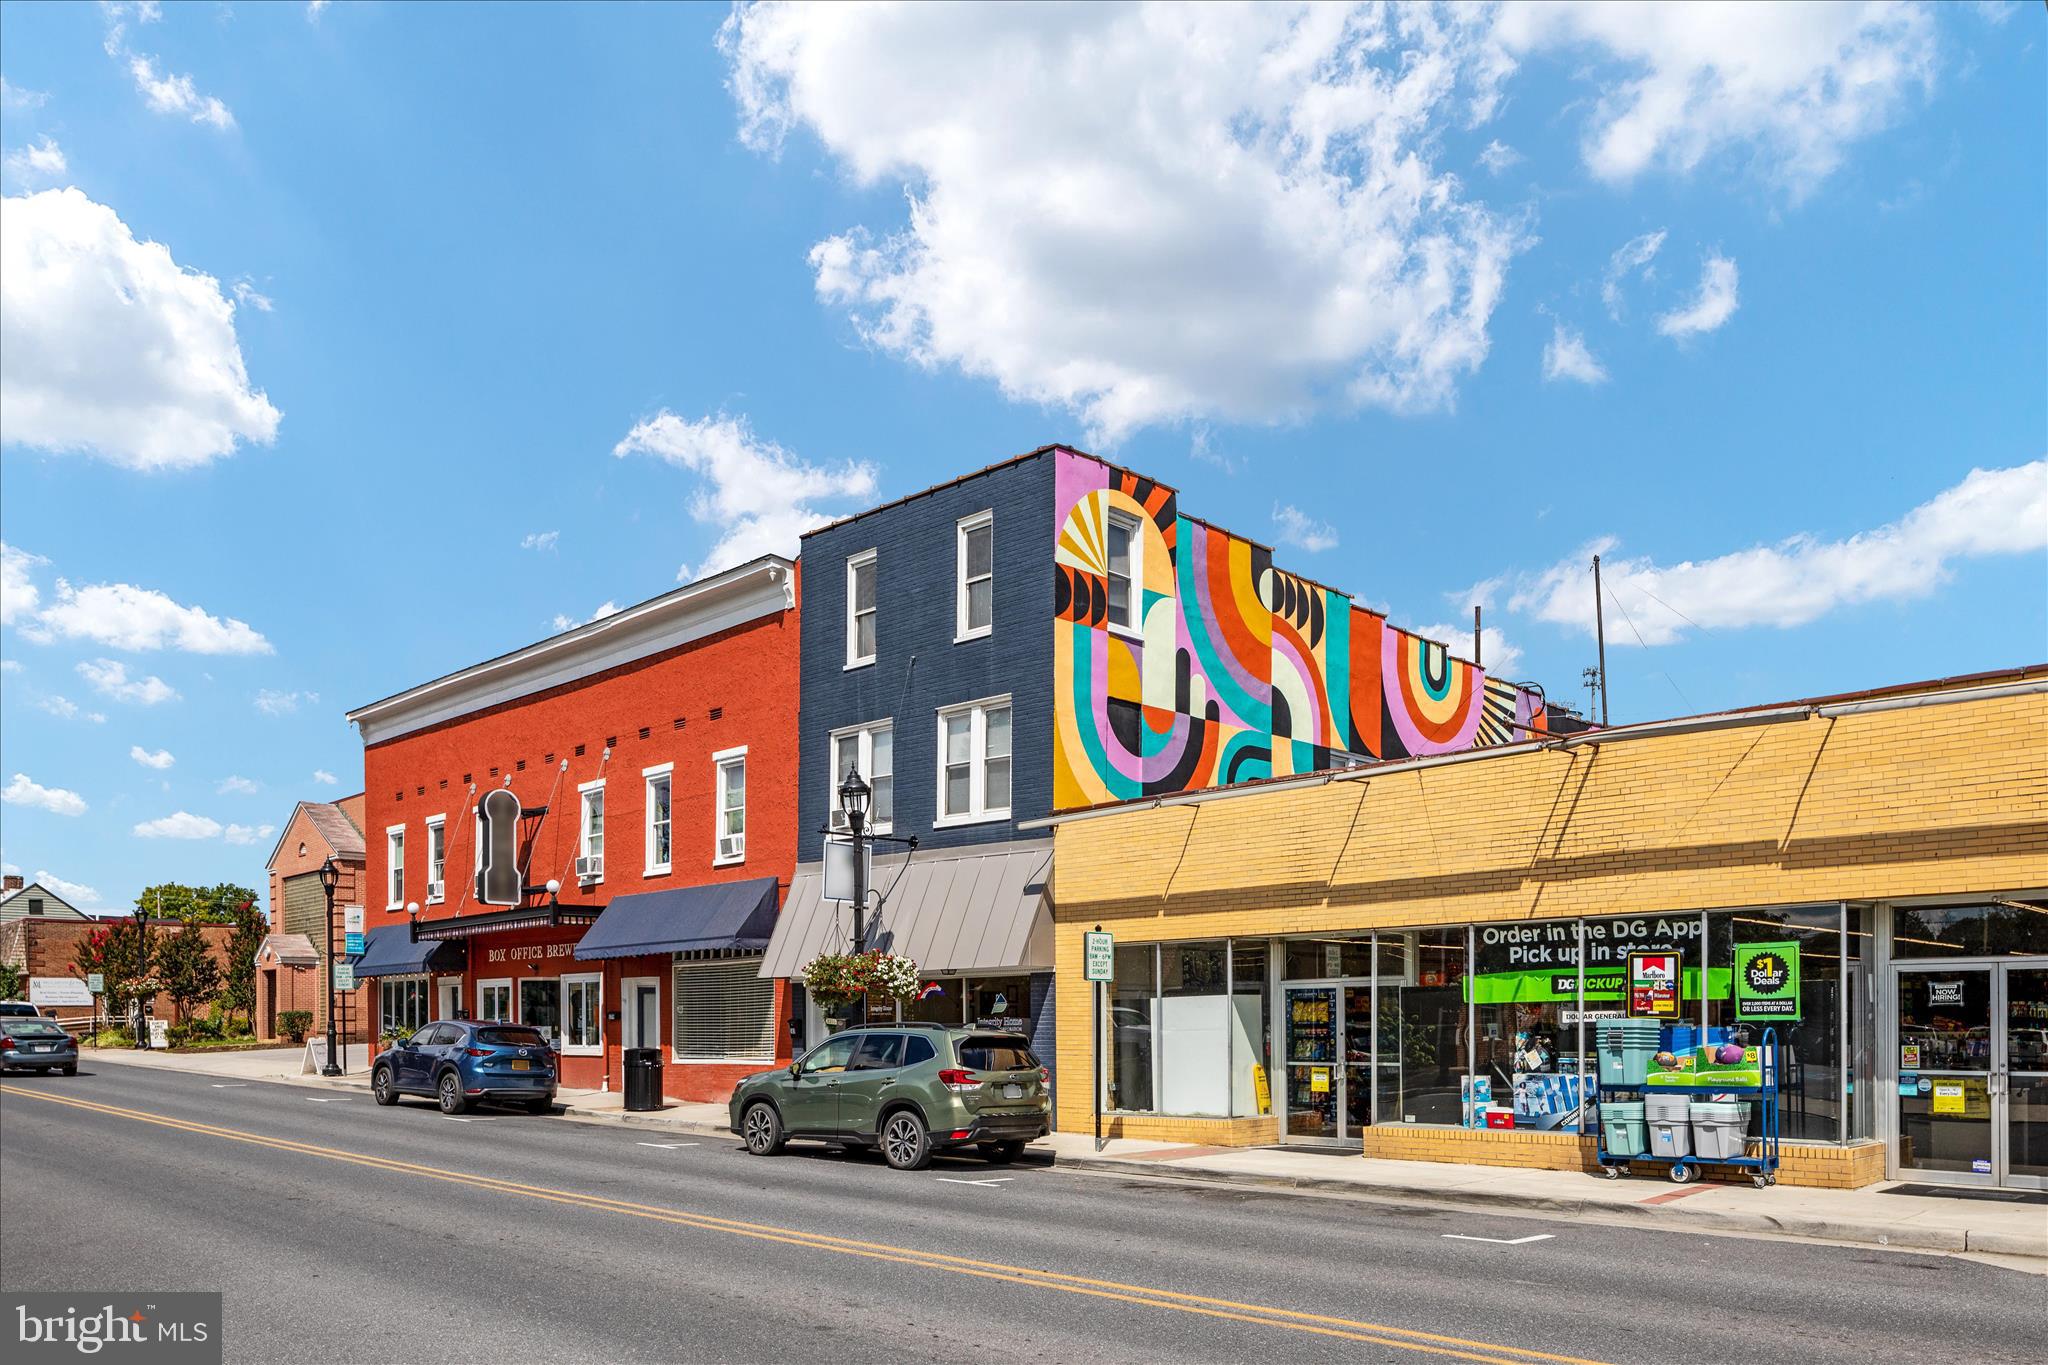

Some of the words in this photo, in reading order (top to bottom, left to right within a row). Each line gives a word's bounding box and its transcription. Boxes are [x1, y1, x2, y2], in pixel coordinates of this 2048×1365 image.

[1483, 926, 1541, 944] Order
[1547, 924, 1566, 941] in
[1613, 920, 1648, 938] DG
[1655, 919, 1702, 940] App
[489, 949, 506, 962] BOX
[511, 946, 543, 960] OFFICE
[1509, 944, 1552, 963] Pick
[1558, 948, 1580, 964] up
[1591, 943, 1610, 960] in
[1757, 957, 1773, 977] $1
[1642, 970, 1665, 979] Marlboro
[1754, 977, 1780, 985] Deals
[1558, 979, 1575, 990] DG
[977, 1017, 1002, 1027] Integrity
[1004, 1017, 1022, 1026] Home
